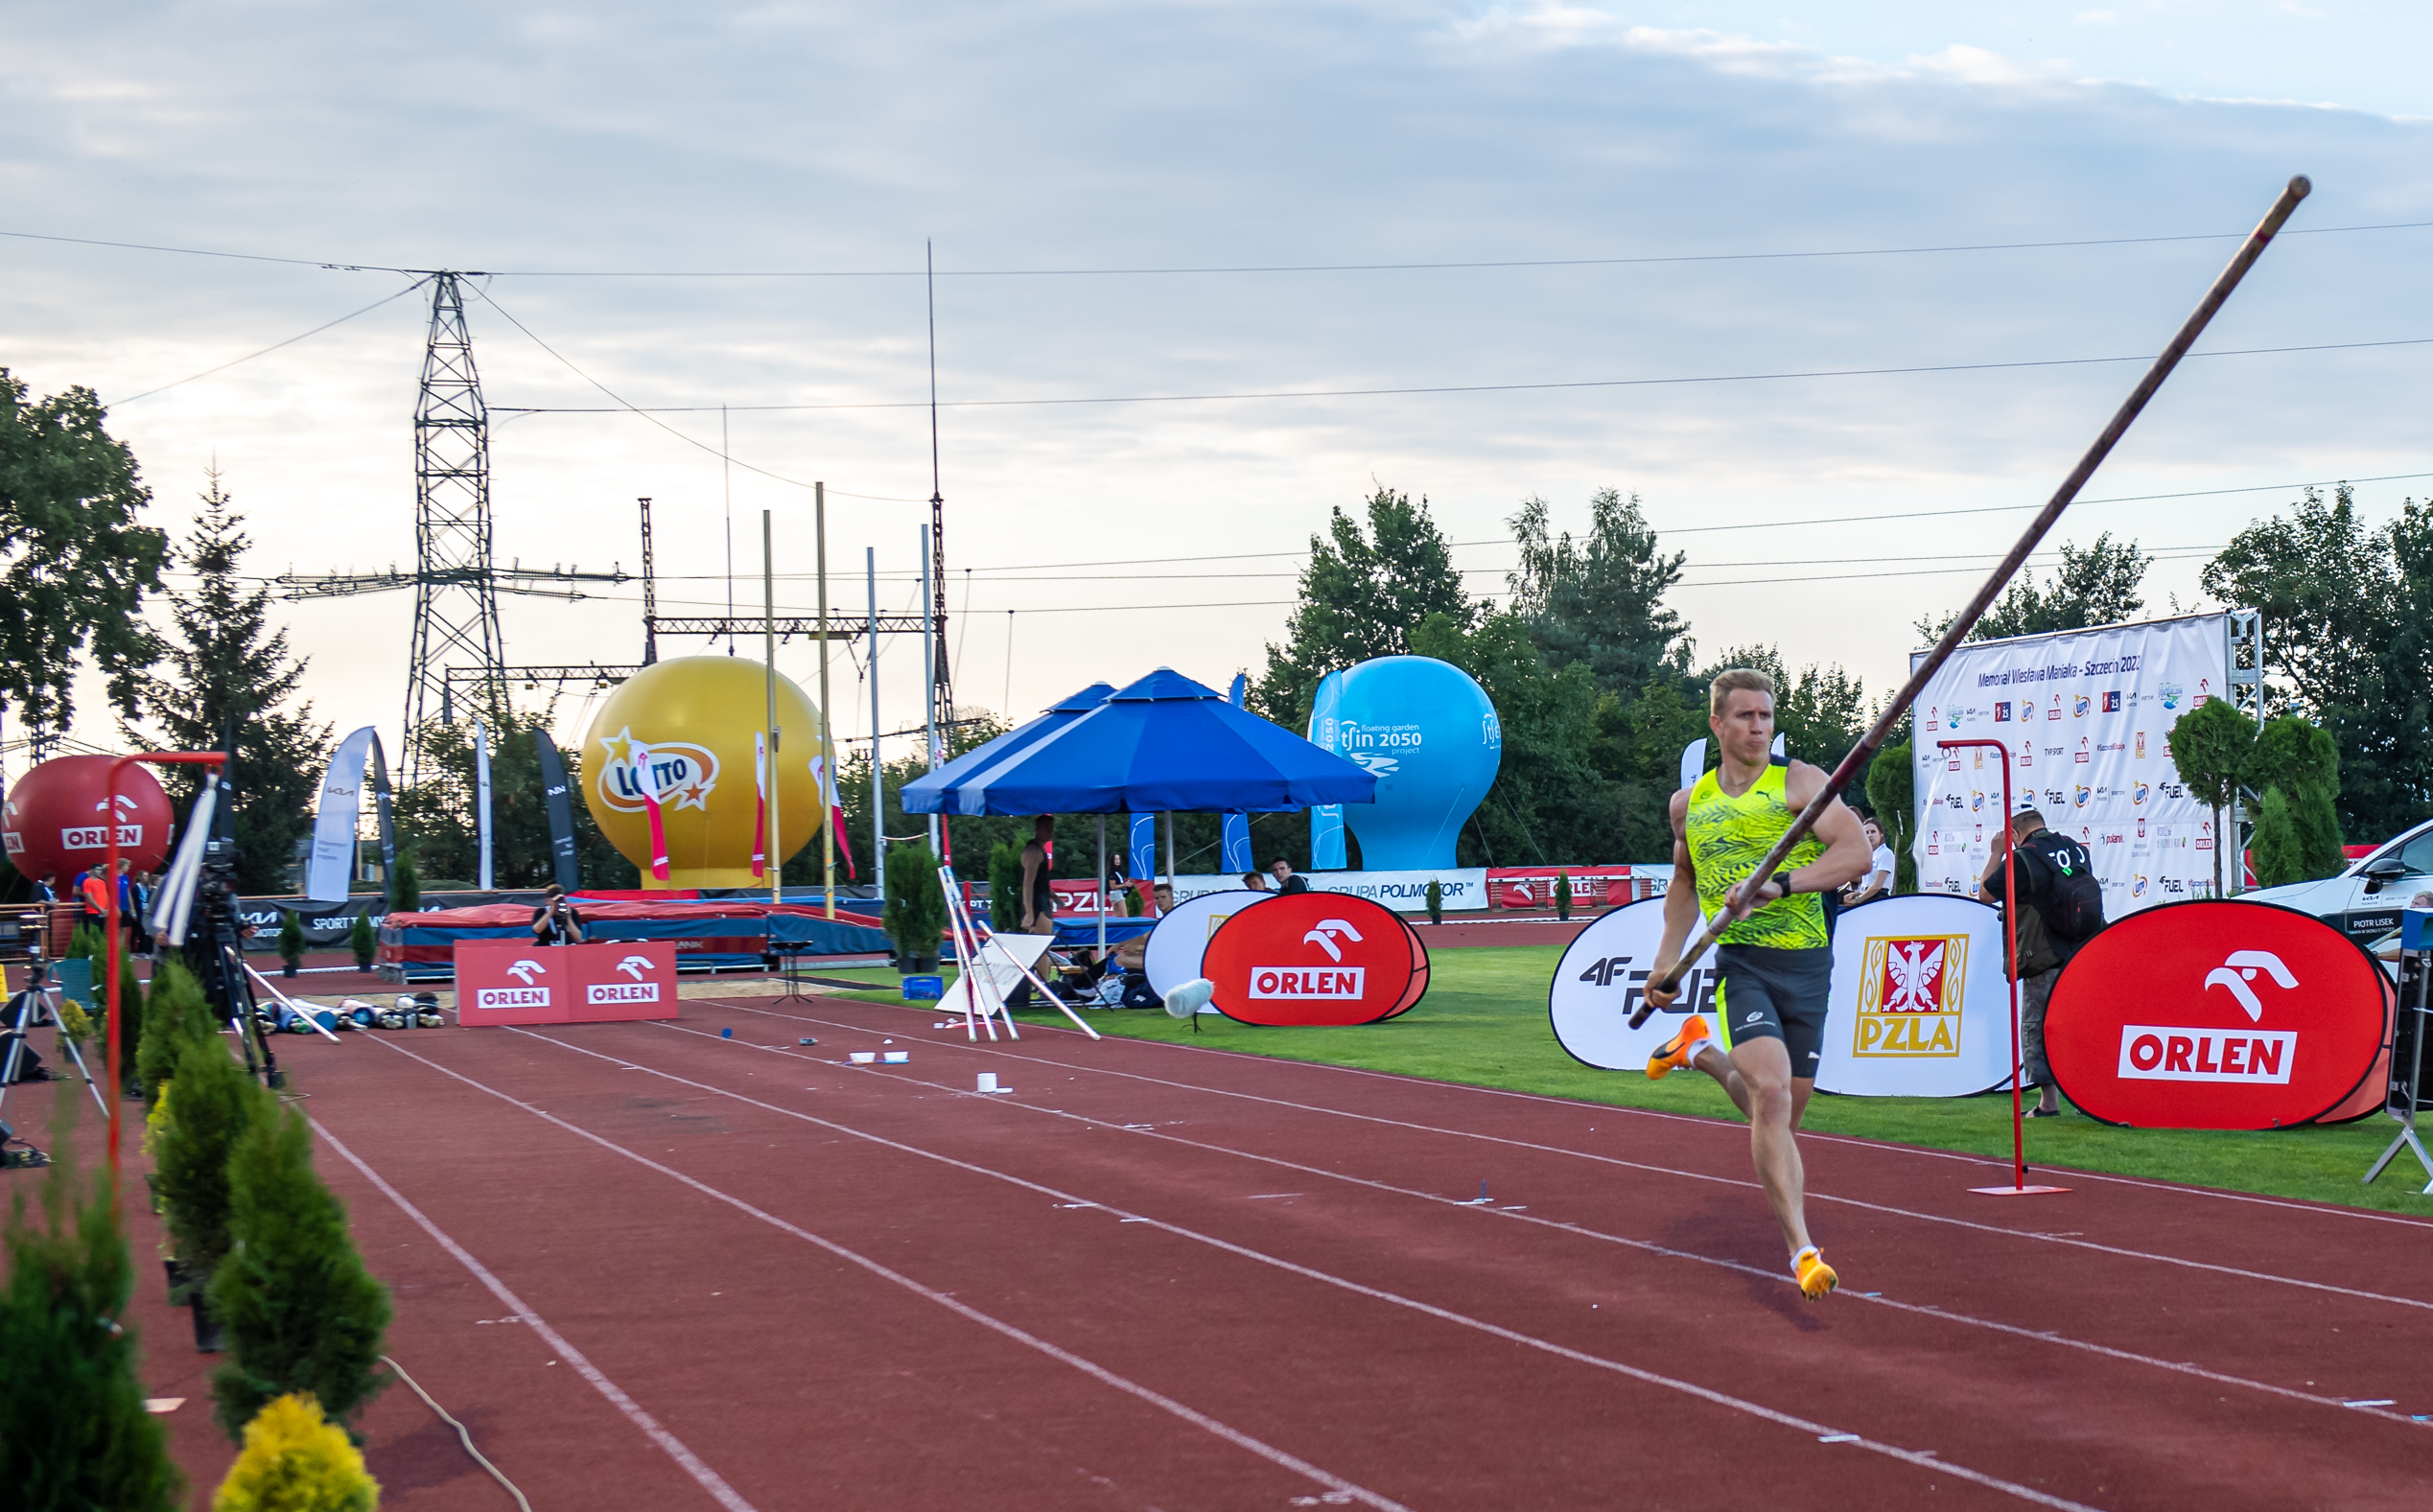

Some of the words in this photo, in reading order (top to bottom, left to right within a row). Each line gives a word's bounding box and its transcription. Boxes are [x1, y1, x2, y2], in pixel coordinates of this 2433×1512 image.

[1977, 669, 2011, 687] Memoriał
[2012, 668, 2046, 685] Wiesława
[2046, 663, 2077, 681] Maniaka
[2084, 658, 2119, 677] Szczecin
[1361, 724, 1390, 733] floating
[1392, 724, 1419, 733] garden
[1379, 733, 1422, 747] 2050
[1392, 747, 1419, 756] project
[2049, 792, 2065, 804] FUEL
[2165, 785, 2184, 799] FUEL
[1951, 797, 1963, 808] FUEL
[2105, 832, 2124, 846] polanik
[1380, 882, 1464, 898] POLMOOR
[1949, 880, 1961, 893] FUEL
[2164, 879, 2184, 893] FUEL
[1052, 892, 1114, 912] PZL
[313, 917, 348, 931] SPORT
[2353, 919, 2375, 928] PIOTR
[2375, 918, 2395, 927] LISEK
[1256, 971, 1357, 995] ORLEN
[483, 990, 545, 1007] ORLEN
[594, 986, 653, 1001] ORLEN
[1622, 968, 1717, 1015] FUE
[1860, 1016, 1953, 1051] PZLA
[2129, 1034, 2283, 1076] ORLEN
